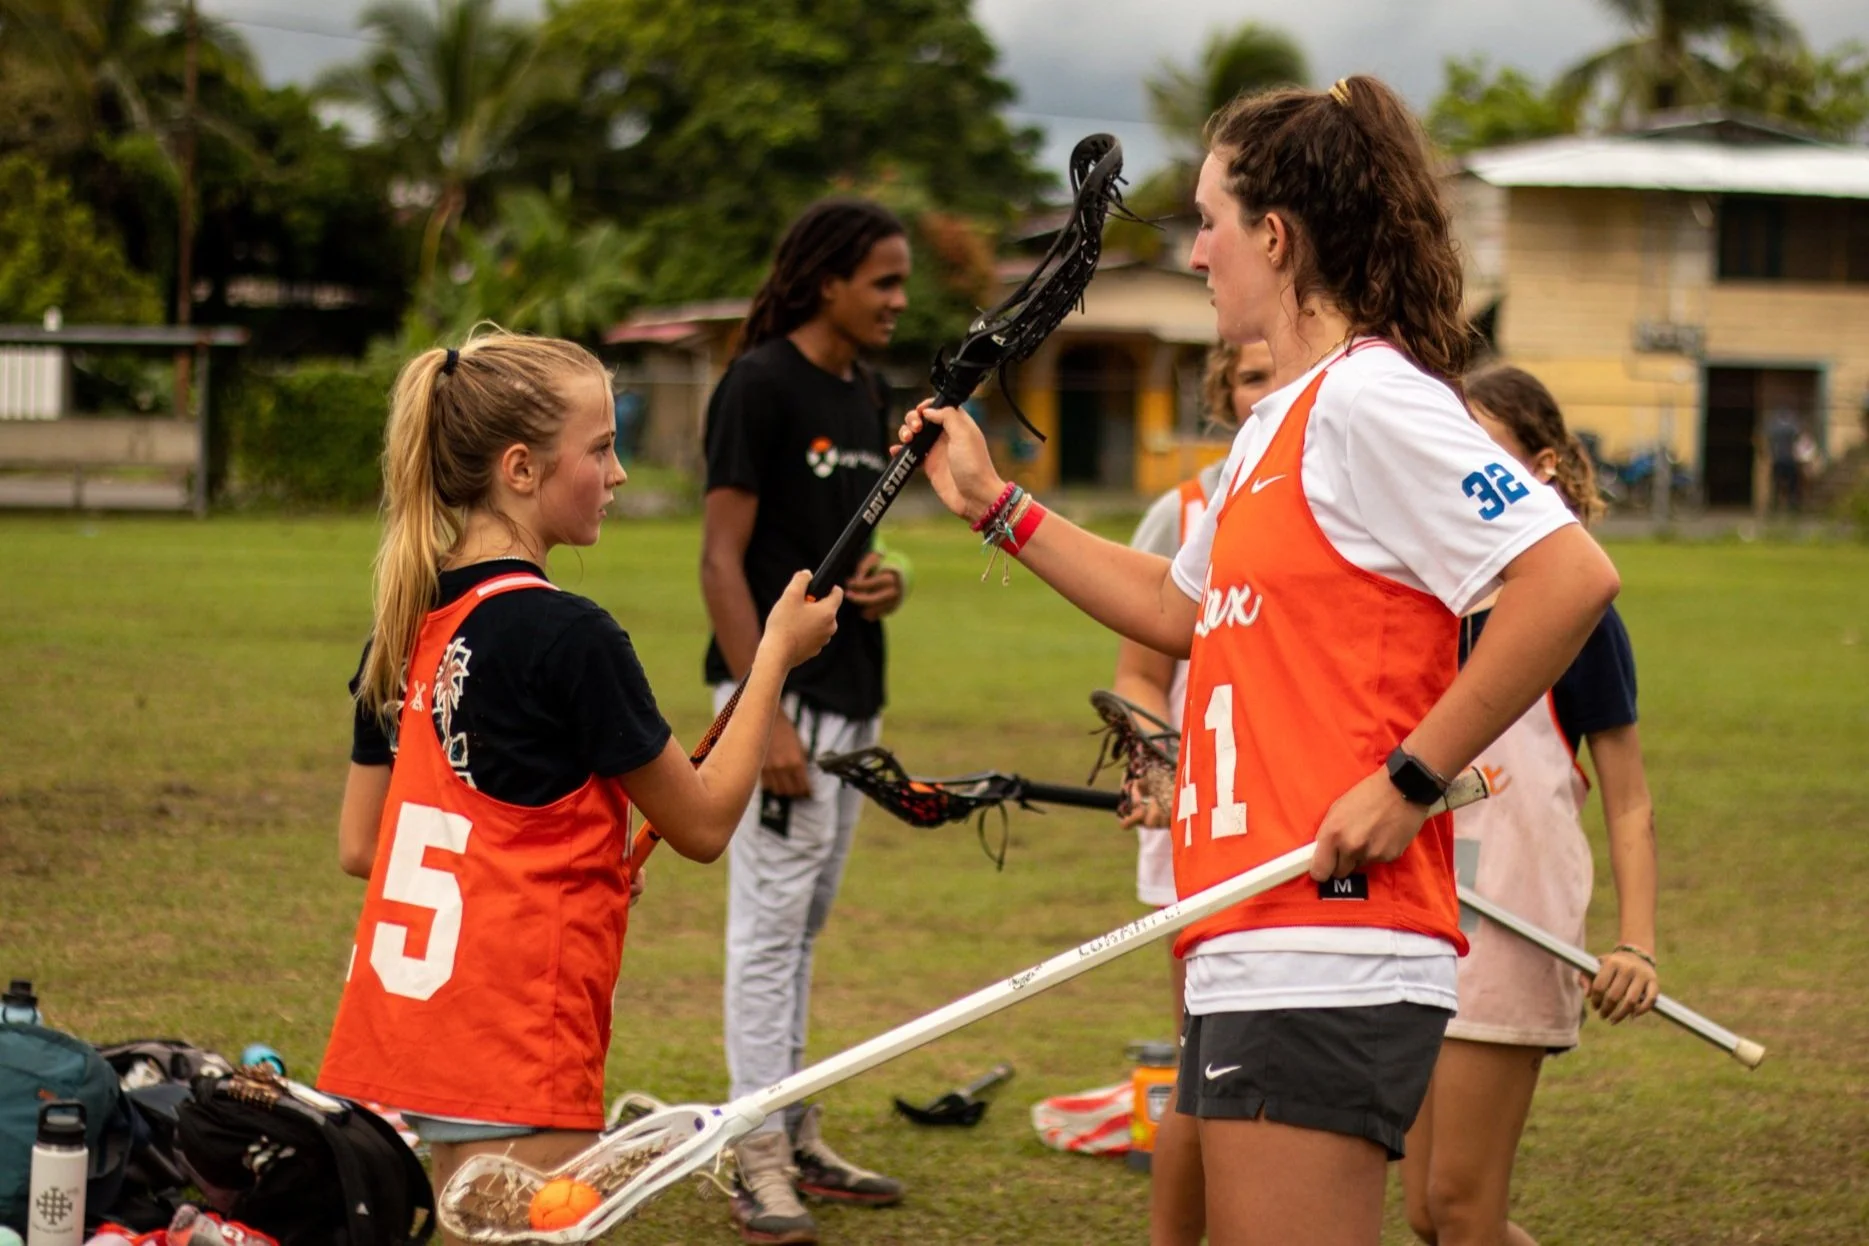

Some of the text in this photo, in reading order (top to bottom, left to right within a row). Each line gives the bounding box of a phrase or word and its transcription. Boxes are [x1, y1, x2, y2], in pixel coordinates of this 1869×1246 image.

[862, 491, 887, 526] BAY
[882, 448, 917, 496] STATE
[1461, 462, 1531, 522] 32
[346, 801, 474, 1002] 5
[1333, 878, 1353, 894] M
